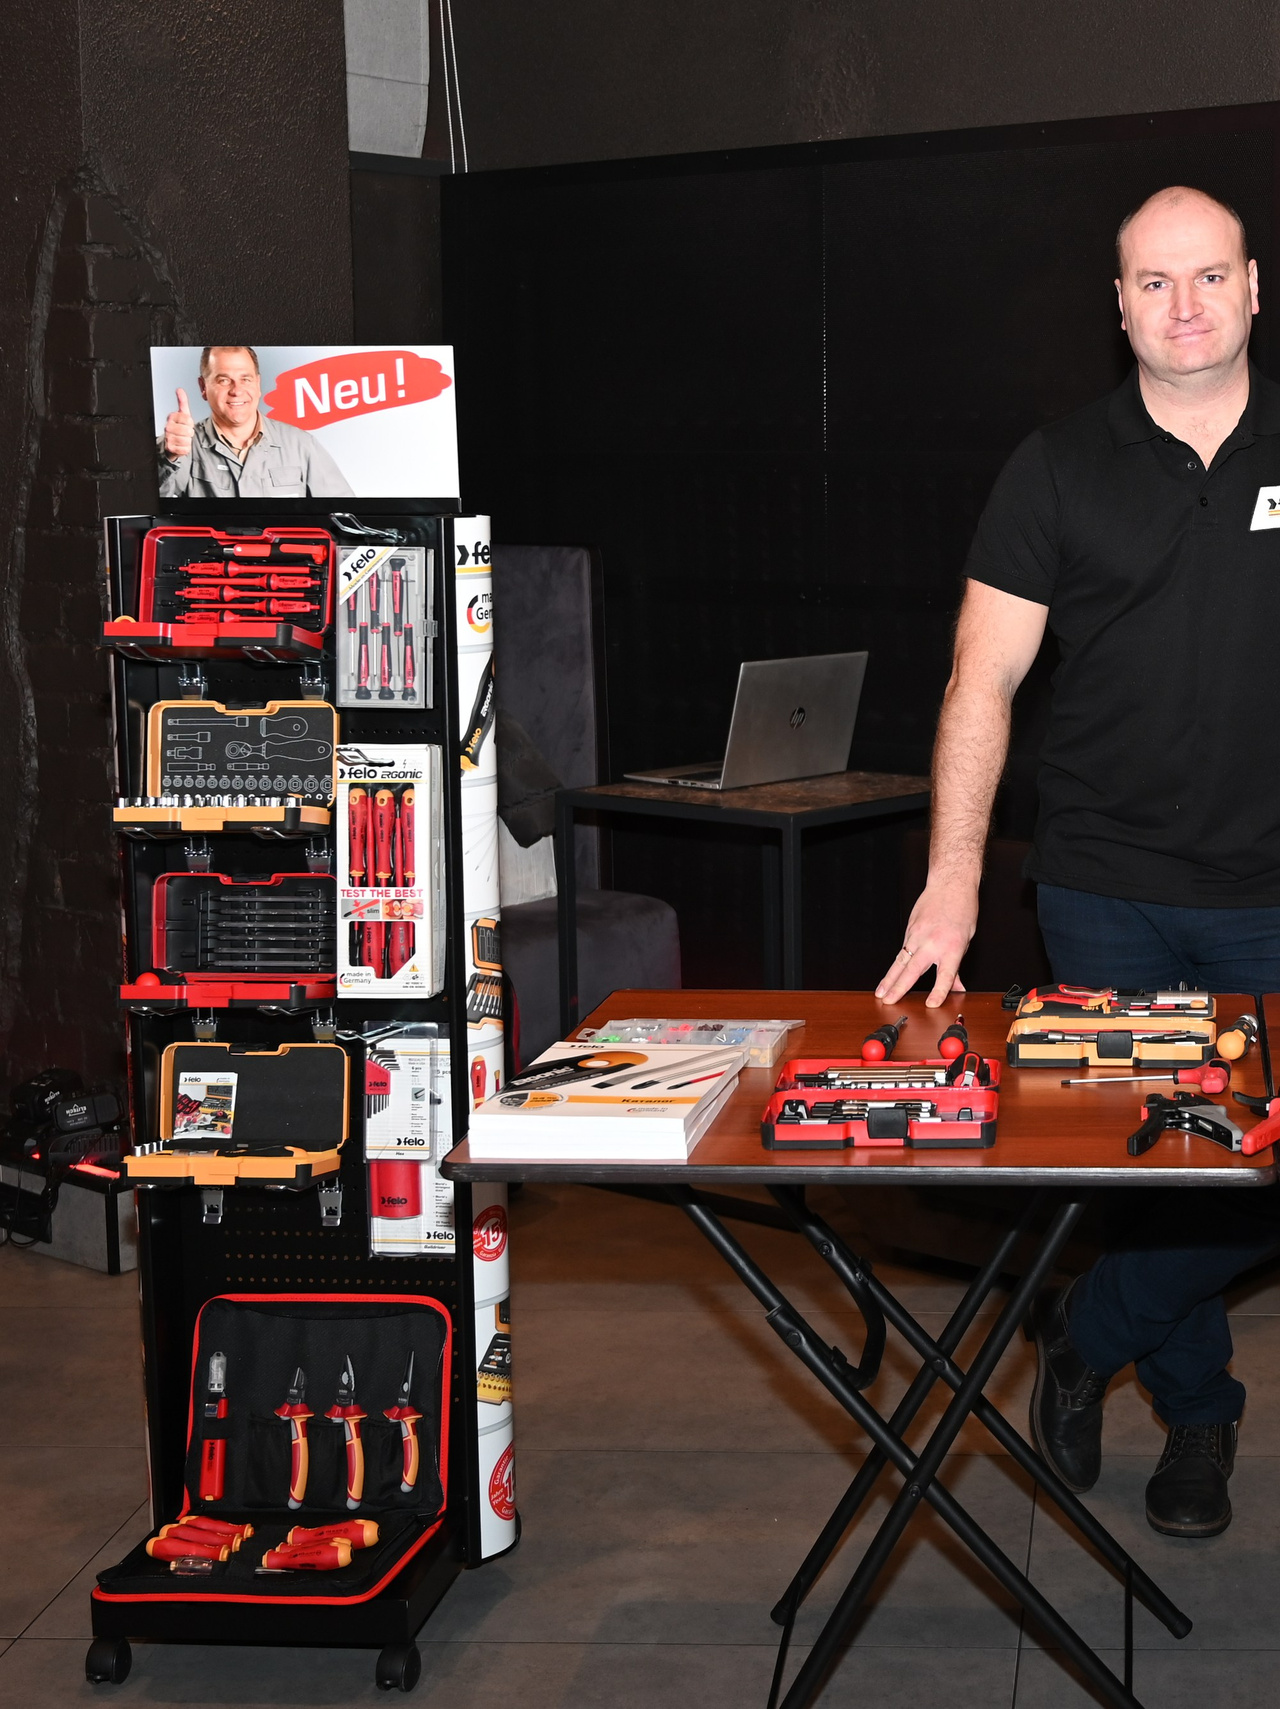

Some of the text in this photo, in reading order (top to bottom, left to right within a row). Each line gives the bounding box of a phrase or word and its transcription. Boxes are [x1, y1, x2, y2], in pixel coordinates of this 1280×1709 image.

[294, 372, 386, 418] Neu
[350, 548, 376, 574] felo
[469, 728, 482, 748] felo
[348, 767, 378, 779] felo
[340, 889, 424, 898] TEST THE BEST
[403, 1137, 425, 1146] felo
[387, 1196, 408, 1205] felo
[433, 1231, 454, 1240] felo
